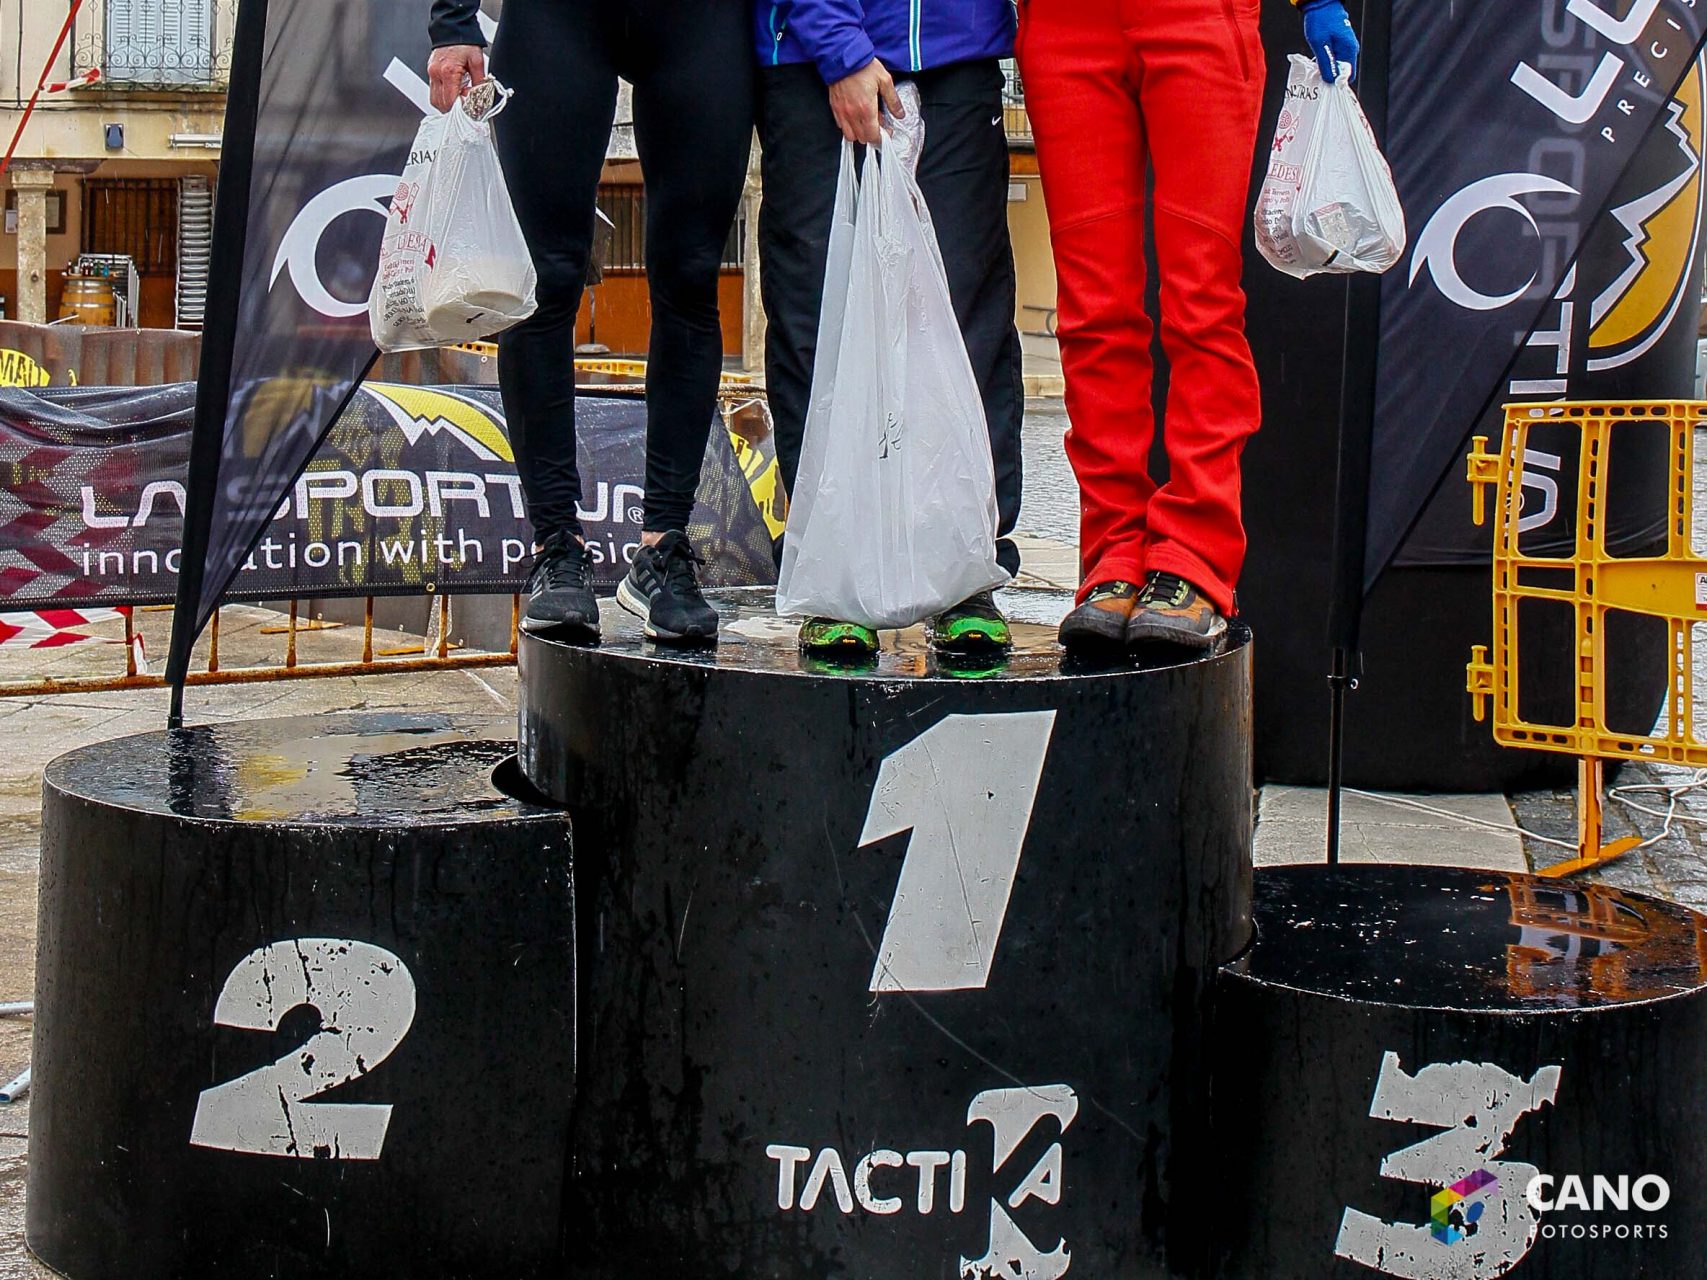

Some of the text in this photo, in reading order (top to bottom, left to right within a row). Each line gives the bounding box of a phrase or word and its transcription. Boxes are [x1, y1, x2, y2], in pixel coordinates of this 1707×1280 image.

[80, 480, 187, 528] LA
[380, 528, 483, 565] with
[859, 709, 1057, 993] 1
[189, 937, 417, 1160] 2
[1335, 1050, 1562, 1280] 3
